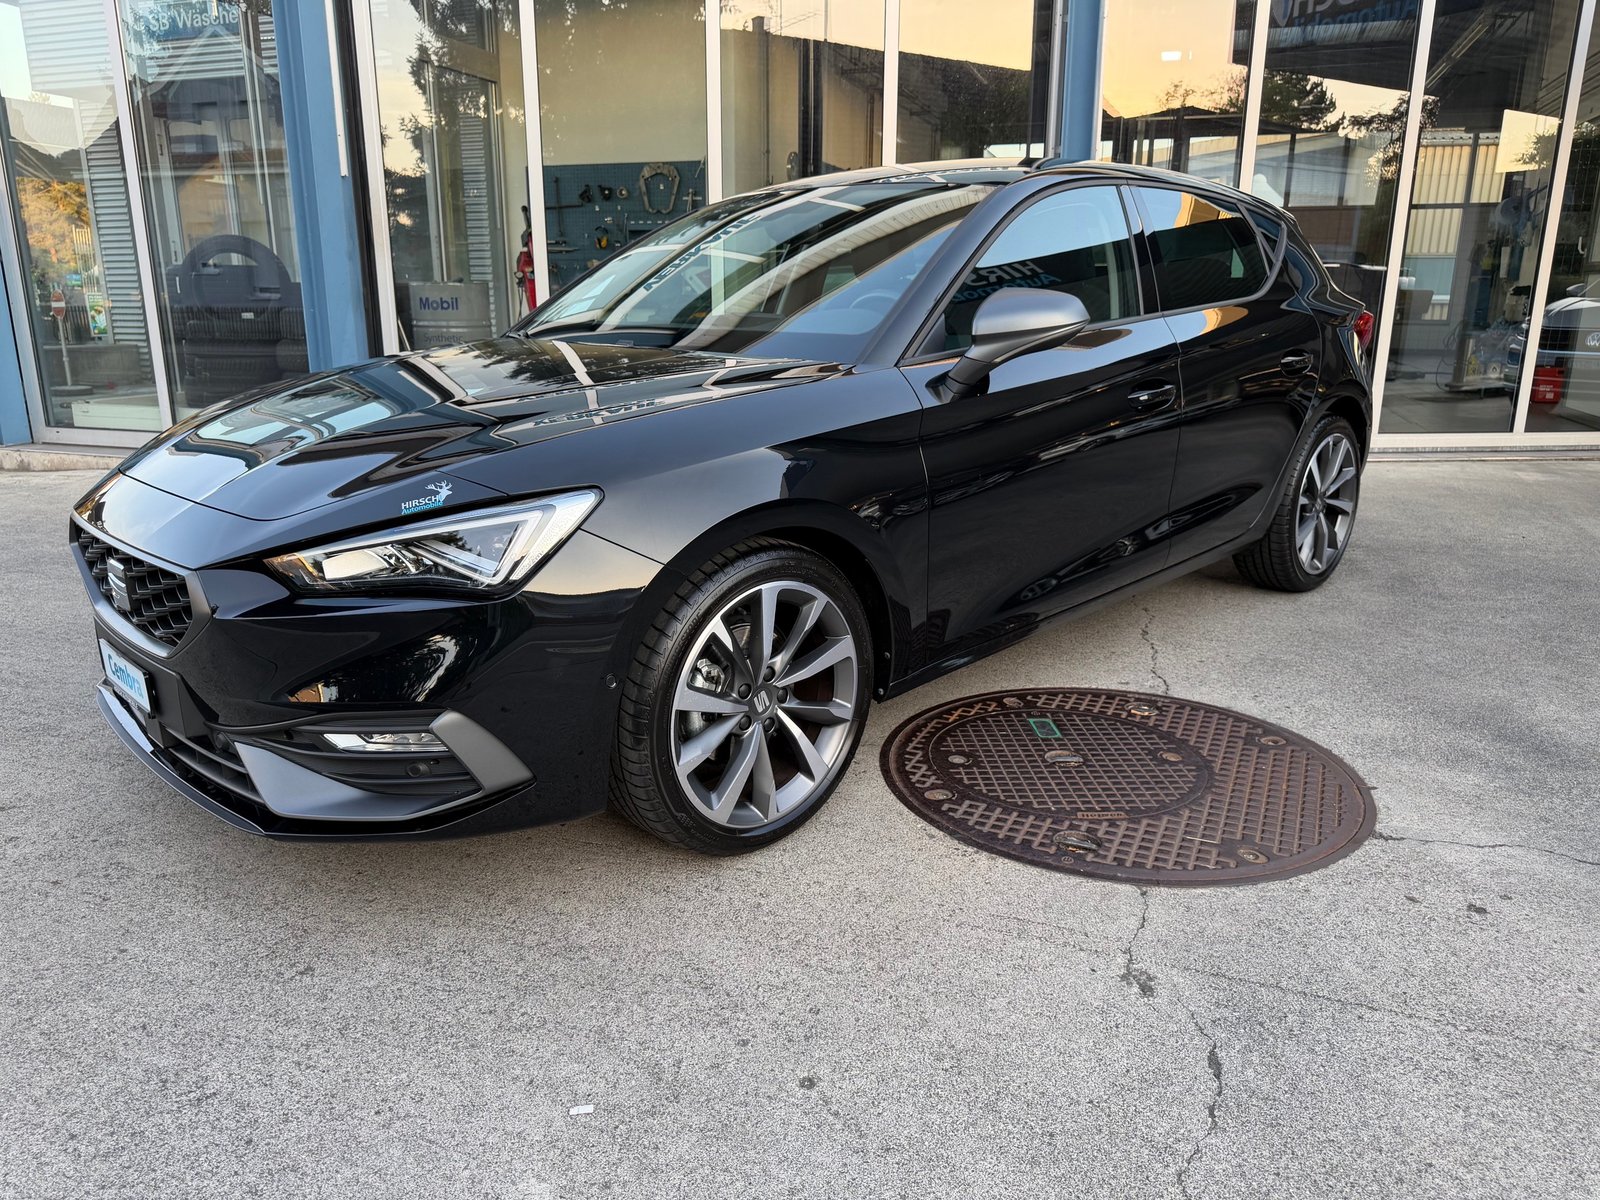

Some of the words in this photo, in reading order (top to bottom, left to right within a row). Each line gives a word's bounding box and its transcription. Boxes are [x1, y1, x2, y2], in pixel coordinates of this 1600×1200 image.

[174, 5, 239, 28] Wäsche
[419, 297, 459, 311] Mobil
[401, 494, 440, 509] HIRSCH
[401, 501, 444, 515] Automobile
[108, 653, 145, 699] Cembra
